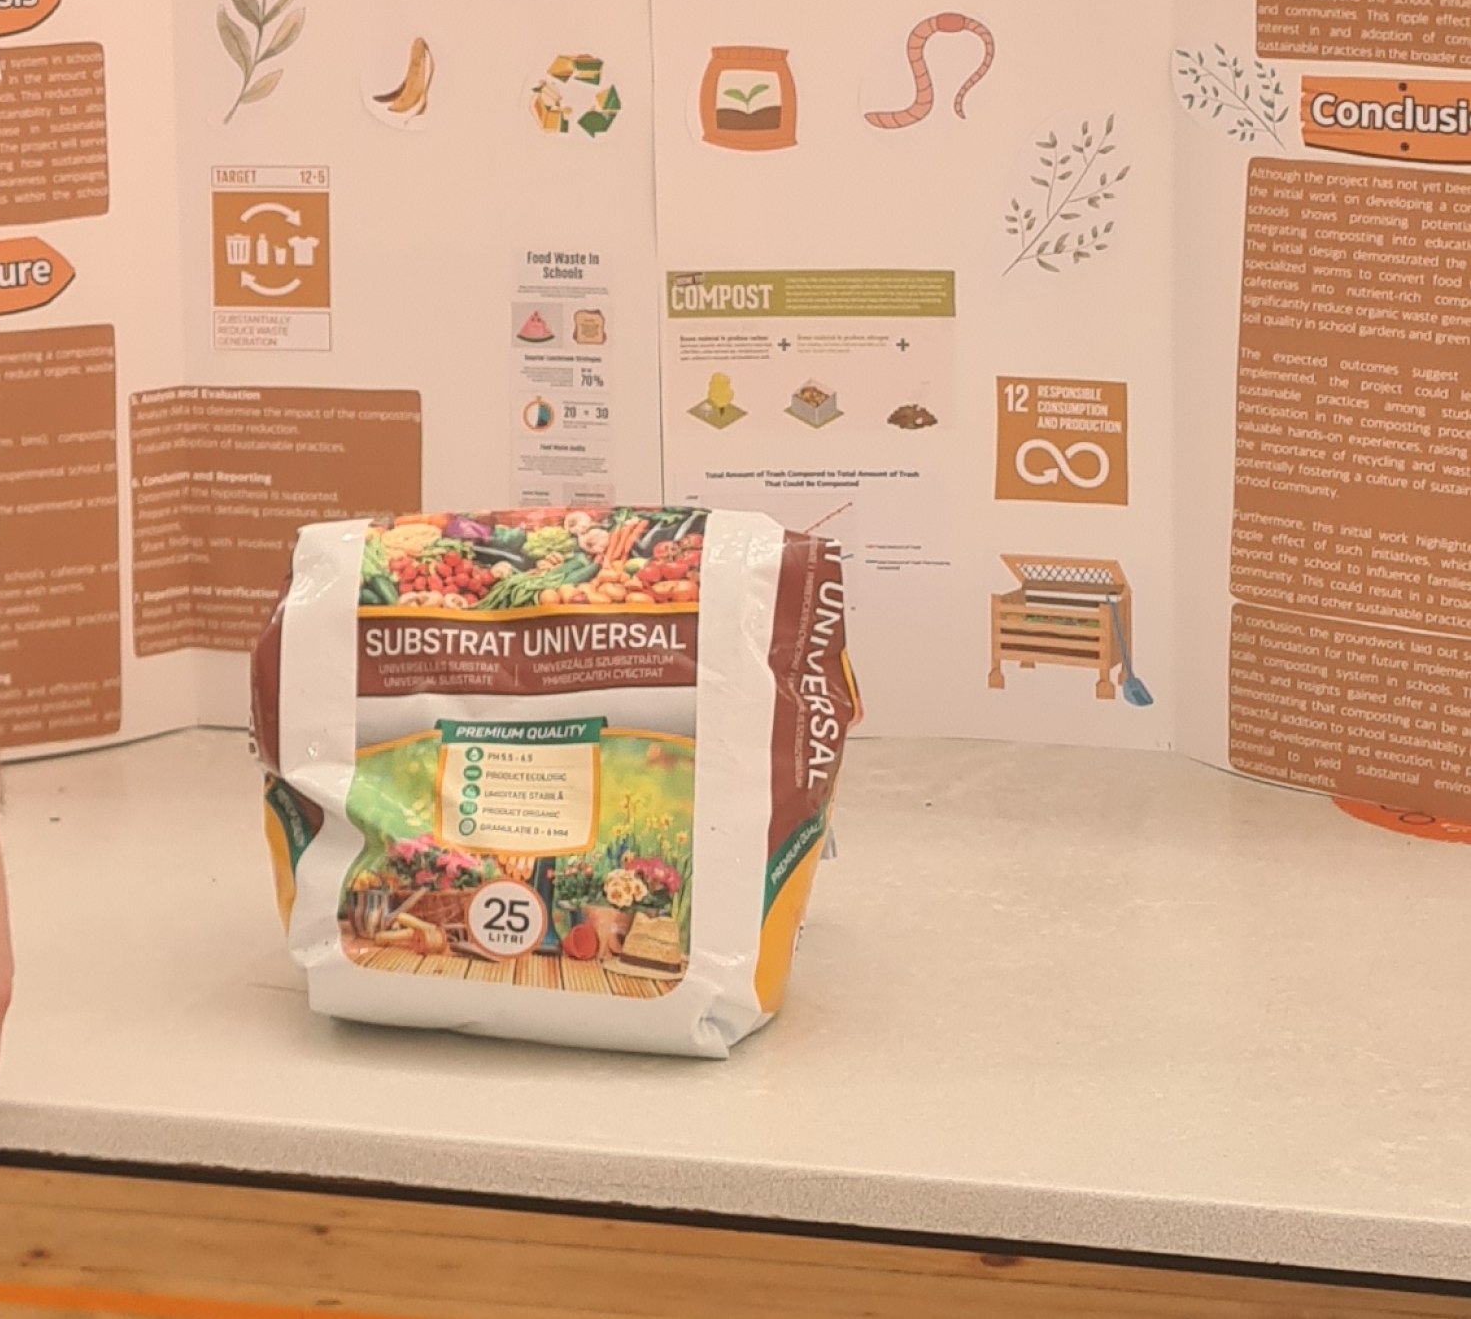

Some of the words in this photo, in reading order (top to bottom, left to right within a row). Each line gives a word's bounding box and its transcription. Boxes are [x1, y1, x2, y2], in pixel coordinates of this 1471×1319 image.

[1310, 93, 1471, 135] Conclusi
[216, 170, 257, 183] TARGET
[1251, 168, 1301, 185] Although
[1305, 171, 1324, 184] the
[1327, 173, 1369, 189] project
[1372, 175, 1393, 188] has
[1397, 177, 1417, 189] not
[1422, 178, 1441, 194] yet
[526, 251, 552, 264] Food
[554, 252, 587, 265] Waste
[588, 252, 600, 265] In
[1247, 240, 1266, 252] The
[1273, 242, 1303, 255] initial
[1309, 245, 1347, 262] design
[1353, 248, 1439, 266] demonstrated
[1446, 256, 1467, 269] the
[543, 266, 583, 279] Schools
[670, 284, 774, 311] COMPOST
[217, 315, 291, 325] SUBSTANTIALLY
[217, 326, 256, 336] REDUCE
[257, 326, 289, 336] WASTE
[217, 336, 277, 346] GENERATION
[201, 389, 261, 401] Evaluation
[1004, 383, 1030, 413] 12
[1037, 385, 1102, 401] RESPONSIBLE
[563, 406, 577, 419] 20
[595, 407, 609, 420] 30
[1037, 400, 1109, 417] CONSUMPTION
[1036, 415, 1058, 430] AND
[1059, 417, 1123, 433] PRODUCTION
[216, 471, 272, 486] Reporting
[705, 471, 725, 479] Total
[725, 471, 755, 479] Amount
[756, 470, 765, 479] of
[765, 470, 787, 478] Trash
[787, 470, 827, 479] Compared
[828, 470, 836, 479] to
[837, 470, 857, 479] Total
[858, 470, 888, 479] Amount
[889, 470, 898, 479] of
[899, 470, 920, 479] Trash
[765, 480, 782, 488] That
[782, 480, 805, 488] Could
[806, 480, 816, 488] Be
[816, 480, 860, 489] Composted
[365, 628, 517, 658] SUBSTRAT
[522, 622, 687, 657] UNIVERSAL
[448, 661, 500, 675] SUBSTRAT
[799, 580, 844, 789] UNIVERSAL
[455, 725, 525, 740] PREMIUM
[525, 723, 587, 741] QUALITY
[483, 897, 530, 933] 25
[488, 932, 524, 945] LITRI
